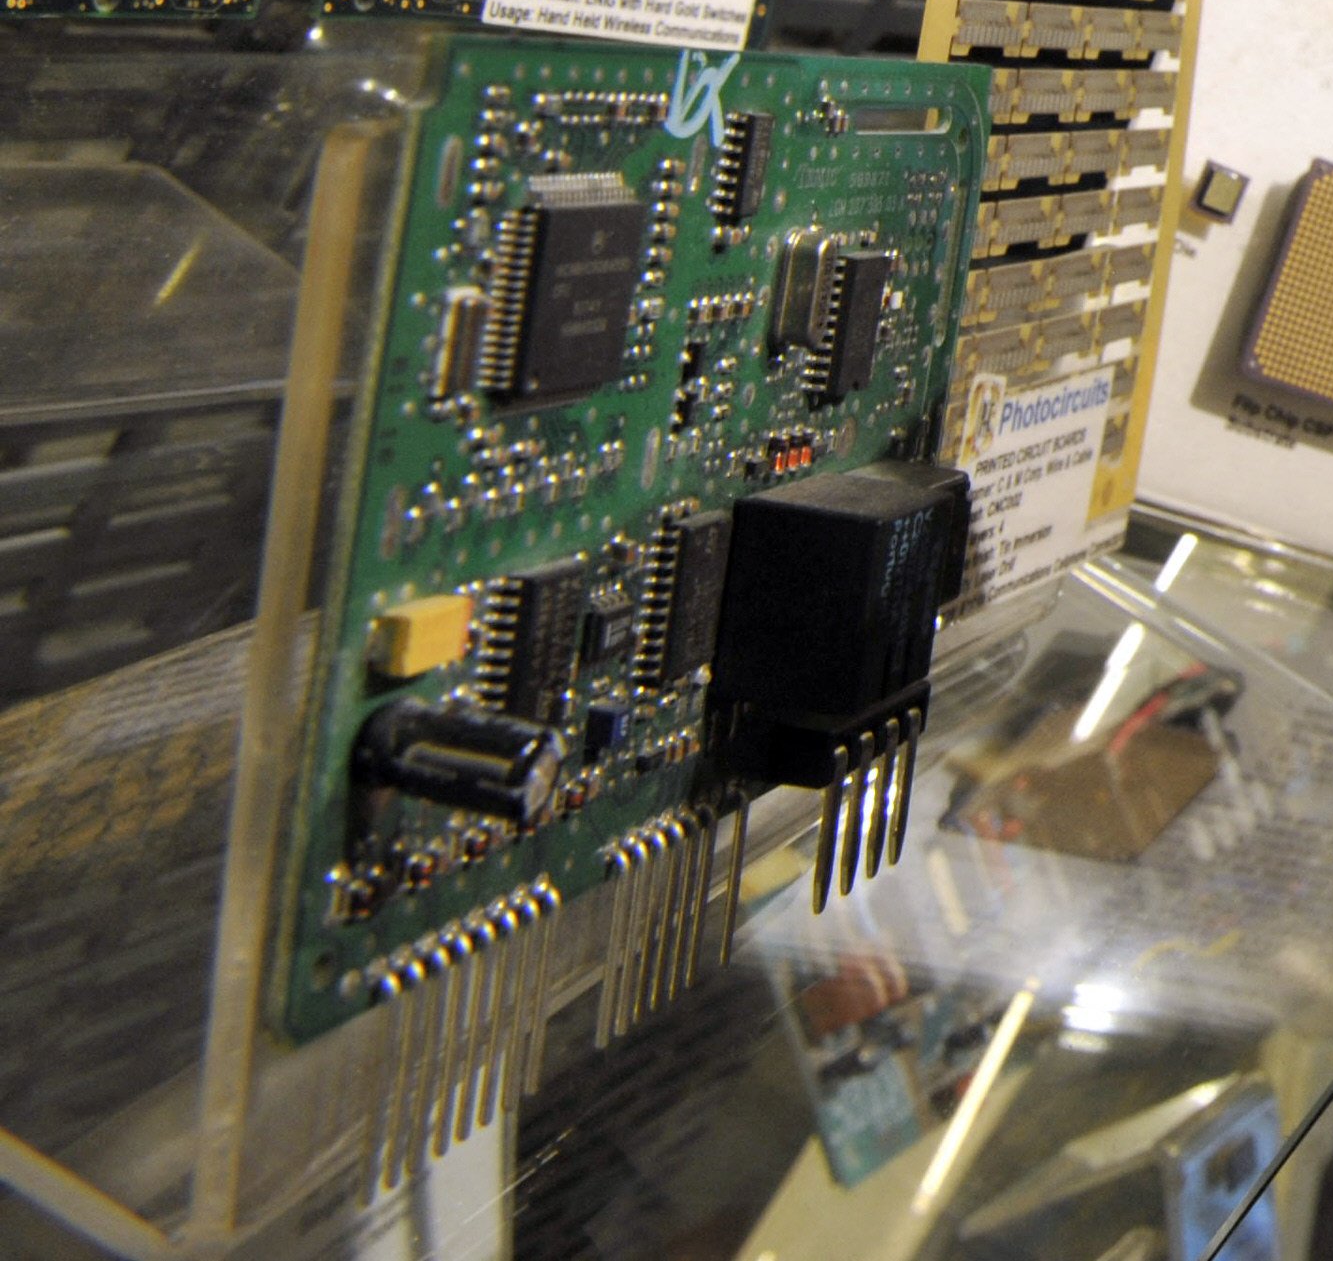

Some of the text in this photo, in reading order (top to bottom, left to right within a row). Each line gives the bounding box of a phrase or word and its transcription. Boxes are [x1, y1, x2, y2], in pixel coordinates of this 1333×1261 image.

[488, 1, 741, 46] Usage: Hand Held Wireless Communications
[674, 1, 701, 20] Gold
[702, 5, 747, 25] Switches
[998, 377, 1110, 435] Photocircuits
[975, 451, 1016, 477] PRINTED
[1016, 438, 1051, 464] CIRCUIT
